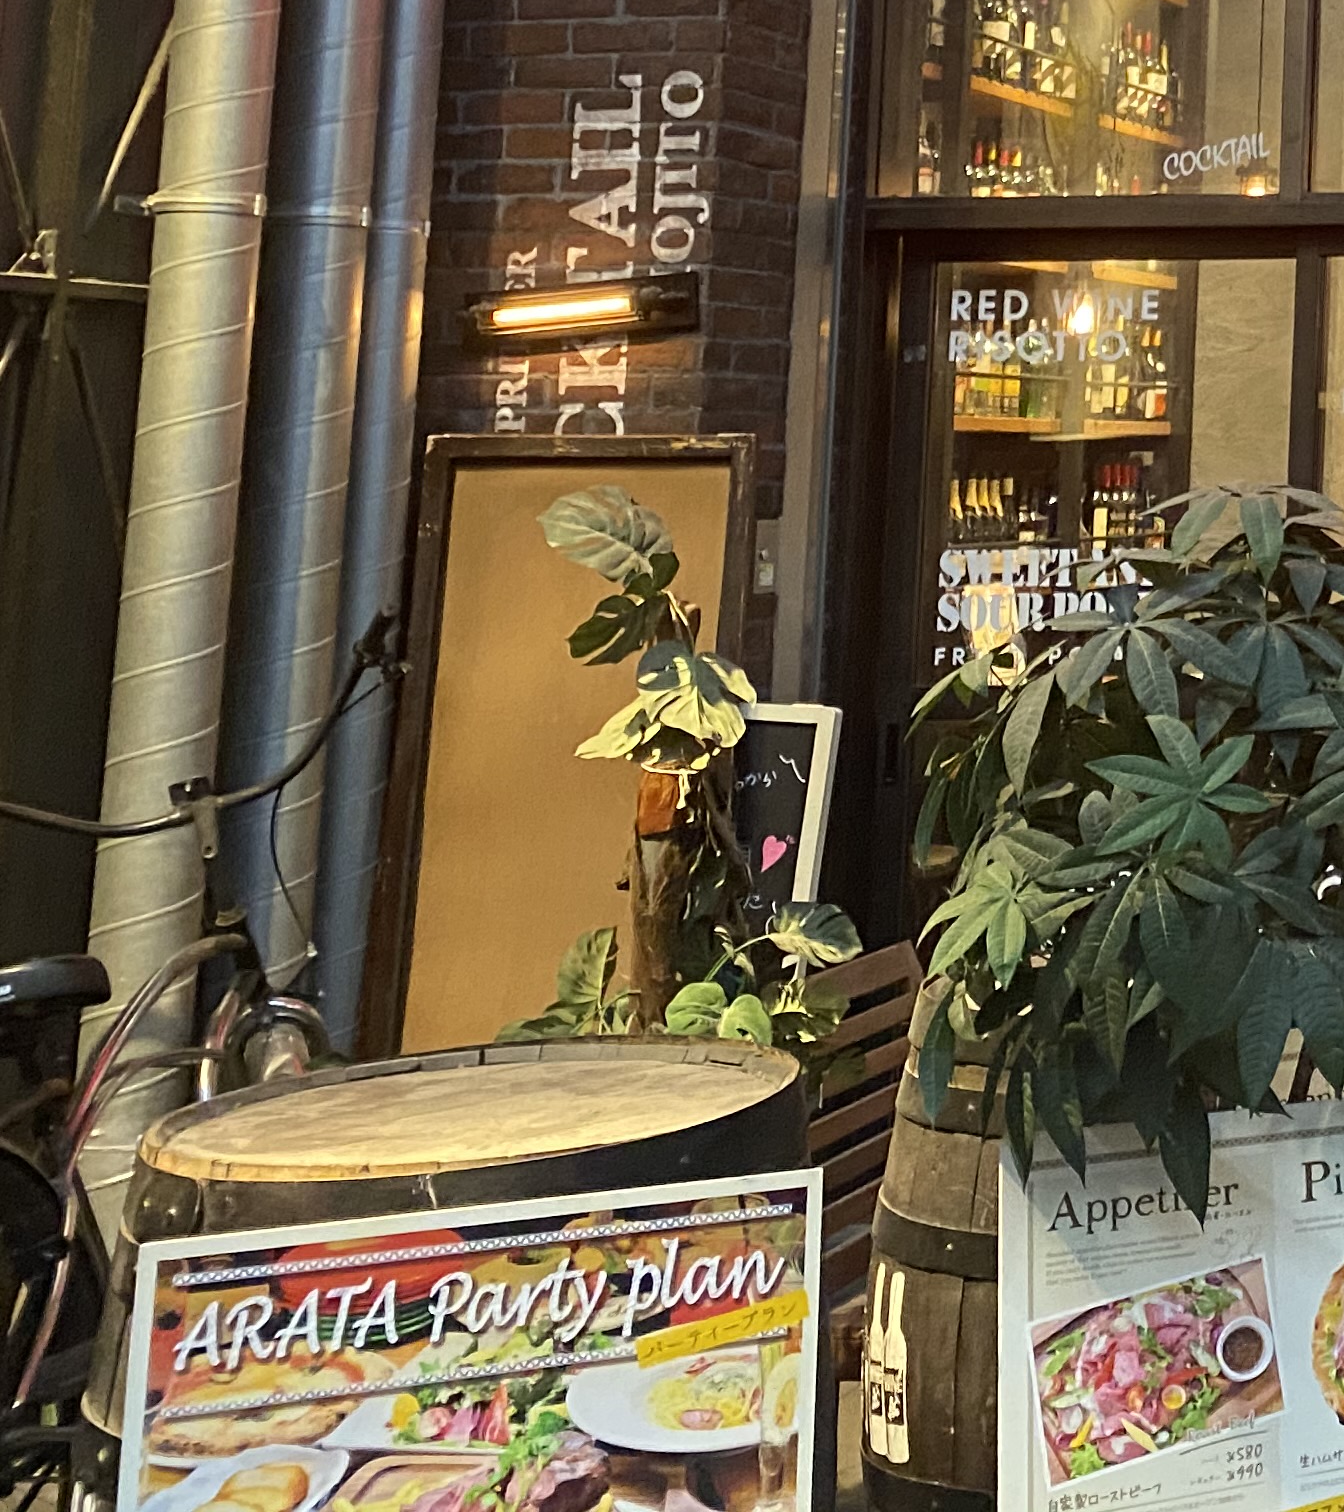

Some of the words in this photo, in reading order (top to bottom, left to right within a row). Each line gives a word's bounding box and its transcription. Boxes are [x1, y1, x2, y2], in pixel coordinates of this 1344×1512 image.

[649, 70, 710, 278] OJITO
[1163, 132, 1270, 181] COCKTAIL
[950, 289, 1029, 321] RED
[1053, 289, 1160, 321] WINE
[948, 330, 1127, 363] RISOTTO
[939, 548, 1078, 588] SWEET
[937, 592, 1046, 632] SOUR
[1047, 1182, 1239, 1234] Appetier
[174, 1278, 400, 1371] ARATA
[428, 1257, 607, 1343] Party
[625, 1238, 786, 1330] plan
[1227, 1443, 1263, 1463] ¥580
[1227, 1463, 1264, 1482] ¥990
